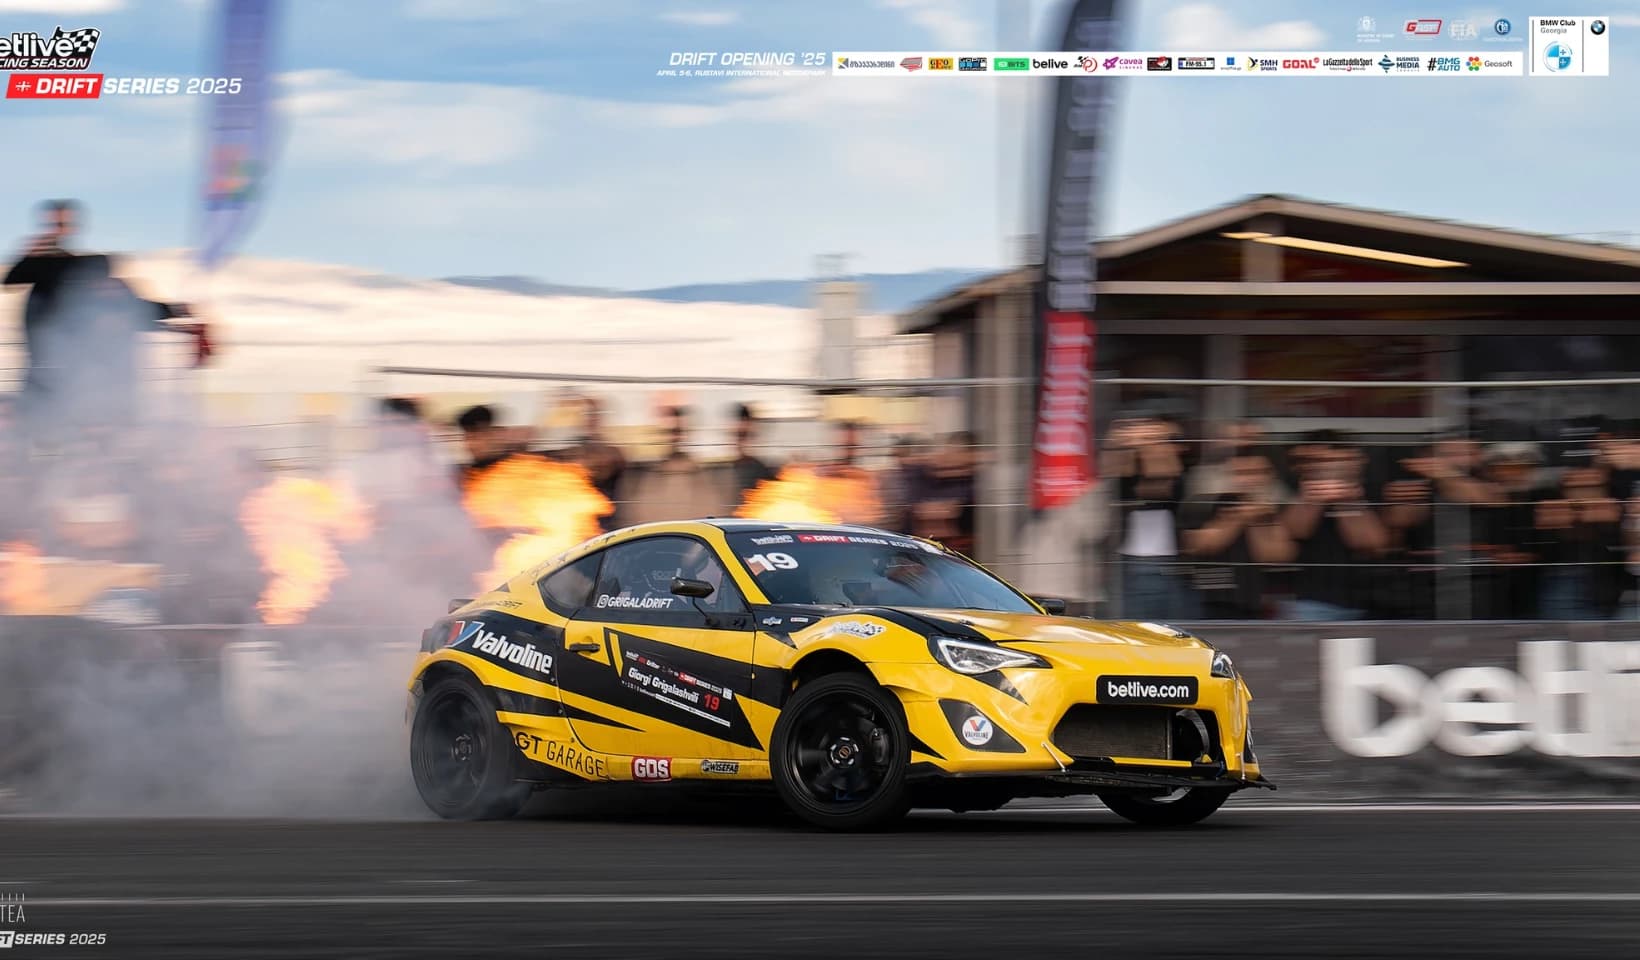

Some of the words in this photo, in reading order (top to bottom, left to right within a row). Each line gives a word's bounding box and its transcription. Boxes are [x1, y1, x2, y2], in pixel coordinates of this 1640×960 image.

[749, 552, 799, 572] 19
[472, 629, 553, 674] Valvoline
[628, 667, 652, 686] Giorgi
[703, 692, 720, 711] 19
[1108, 681, 1189, 698] betlive.com
[515, 732, 543, 754] GT
[546, 741, 604, 778] GARAGE
